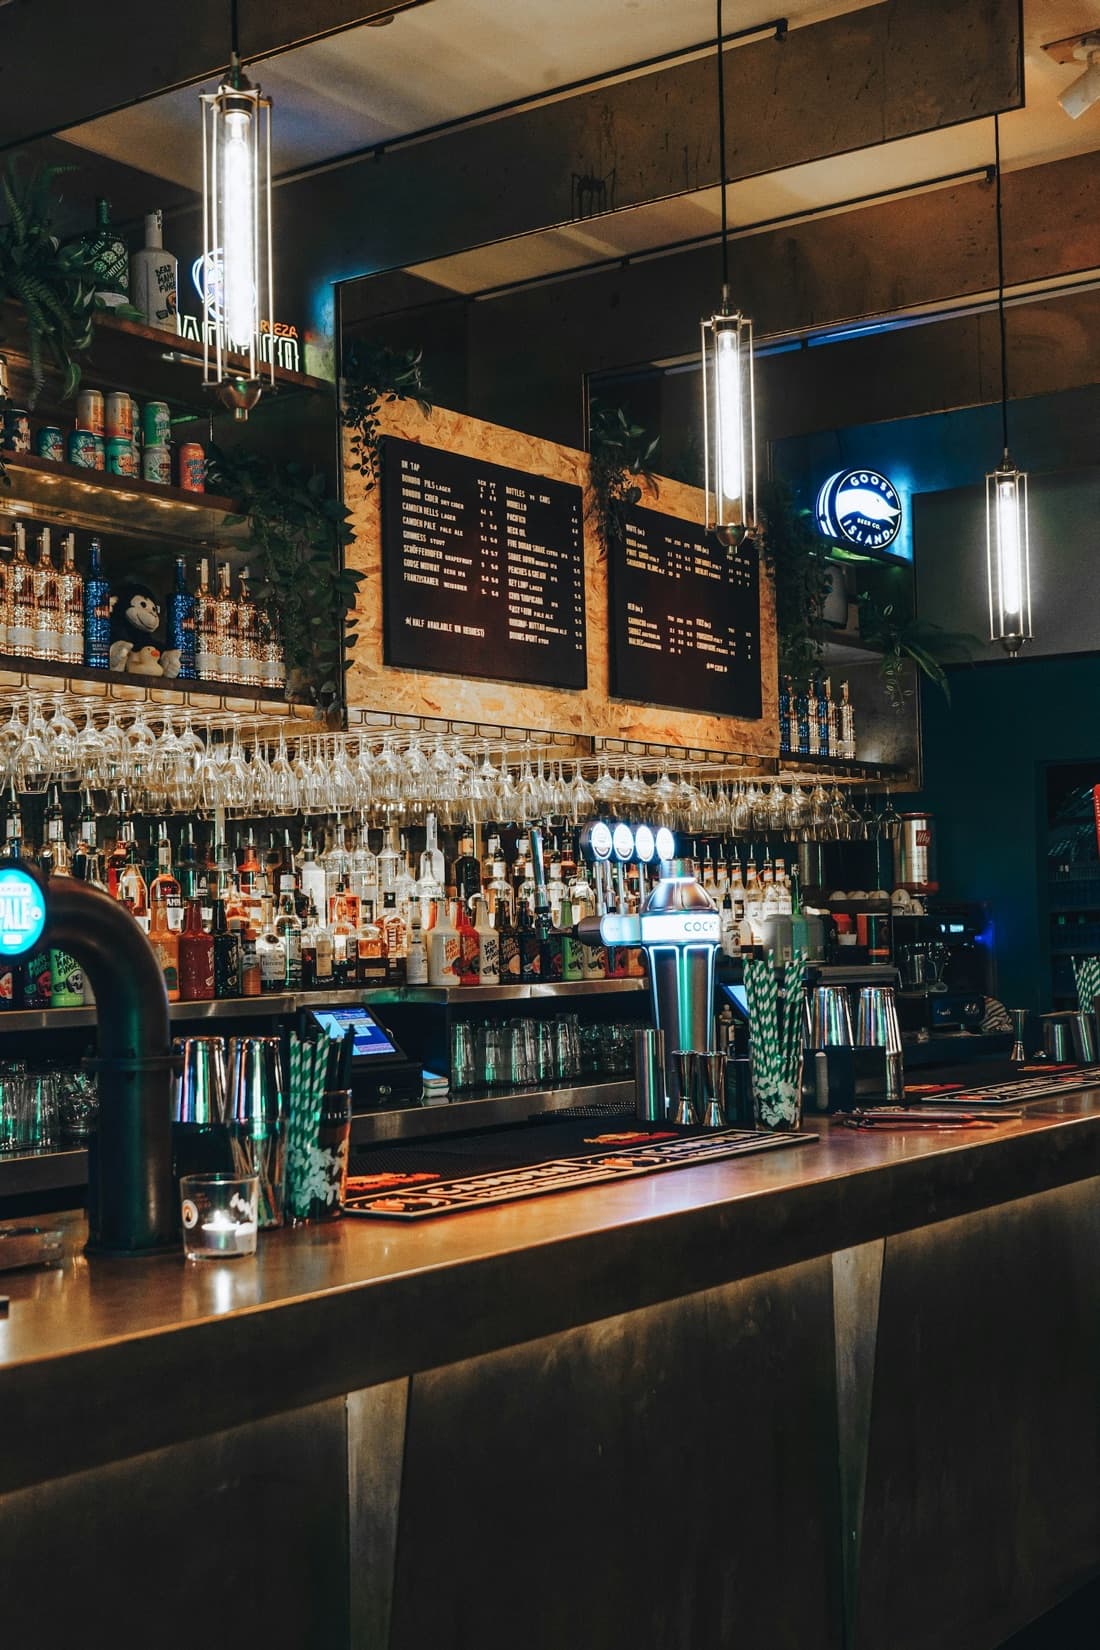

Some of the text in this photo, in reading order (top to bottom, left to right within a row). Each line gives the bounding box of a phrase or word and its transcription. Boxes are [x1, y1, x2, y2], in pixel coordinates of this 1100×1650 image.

[410, 463, 420, 471] TAP
[424, 480, 435, 489] PILS
[850, 474, 894, 500] GOOSE
[506, 486, 525, 497] BOTTLES
[425, 494, 438, 502] CIDER
[402, 502, 422, 514] CAMDEN
[423, 506, 439, 517] HELLS
[403, 517, 423, 528] CAMDEN
[424, 520, 437, 531] PALE
[857, 518, 871, 527] BEER
[843, 520, 891, 545] ISLAND
[427, 620, 452, 631] AVAILABLE
[426, 1166, 580, 1196] CAMDEN
